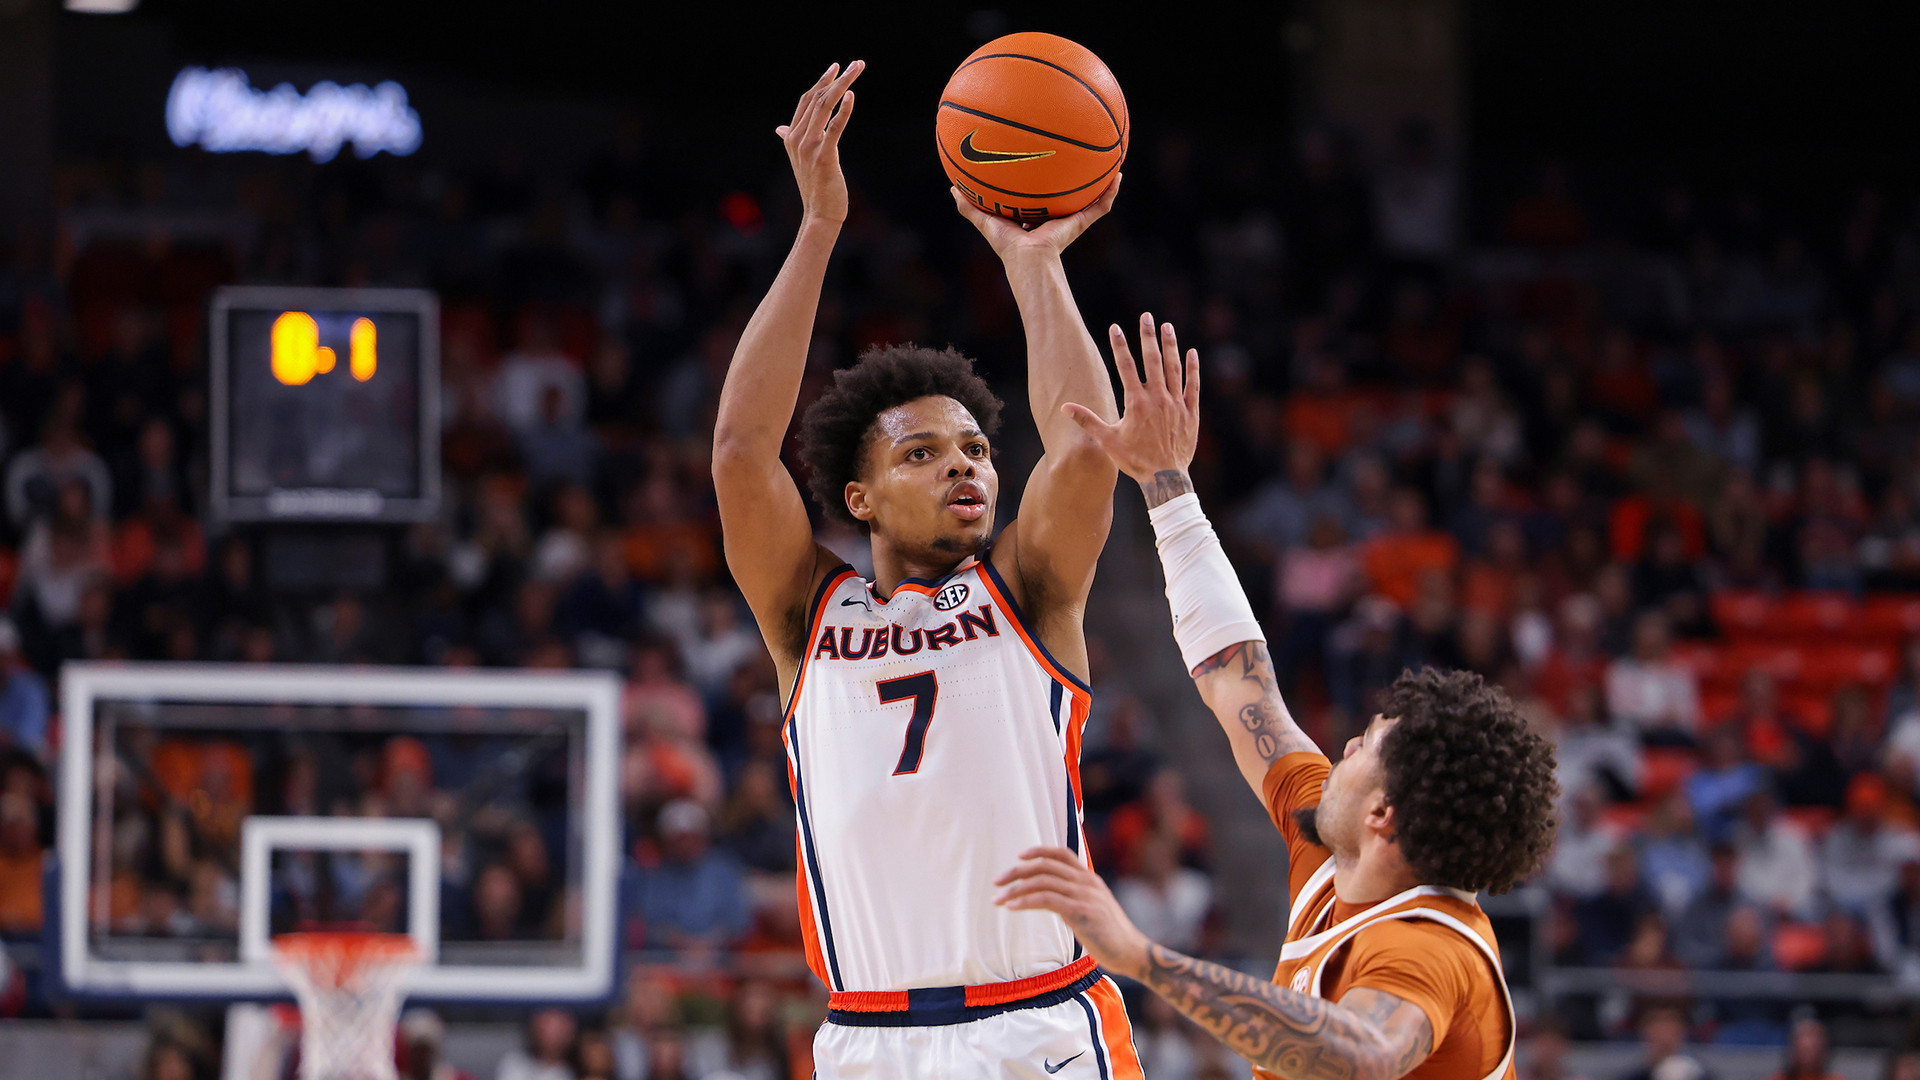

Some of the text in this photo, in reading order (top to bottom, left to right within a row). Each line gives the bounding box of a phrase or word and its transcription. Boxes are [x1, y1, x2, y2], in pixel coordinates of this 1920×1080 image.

[956, 177, 1050, 218] ELITE
[935, 584, 967, 610] SEC
[814, 604, 1000, 661] AUBURN
[876, 670, 939, 776] 7
